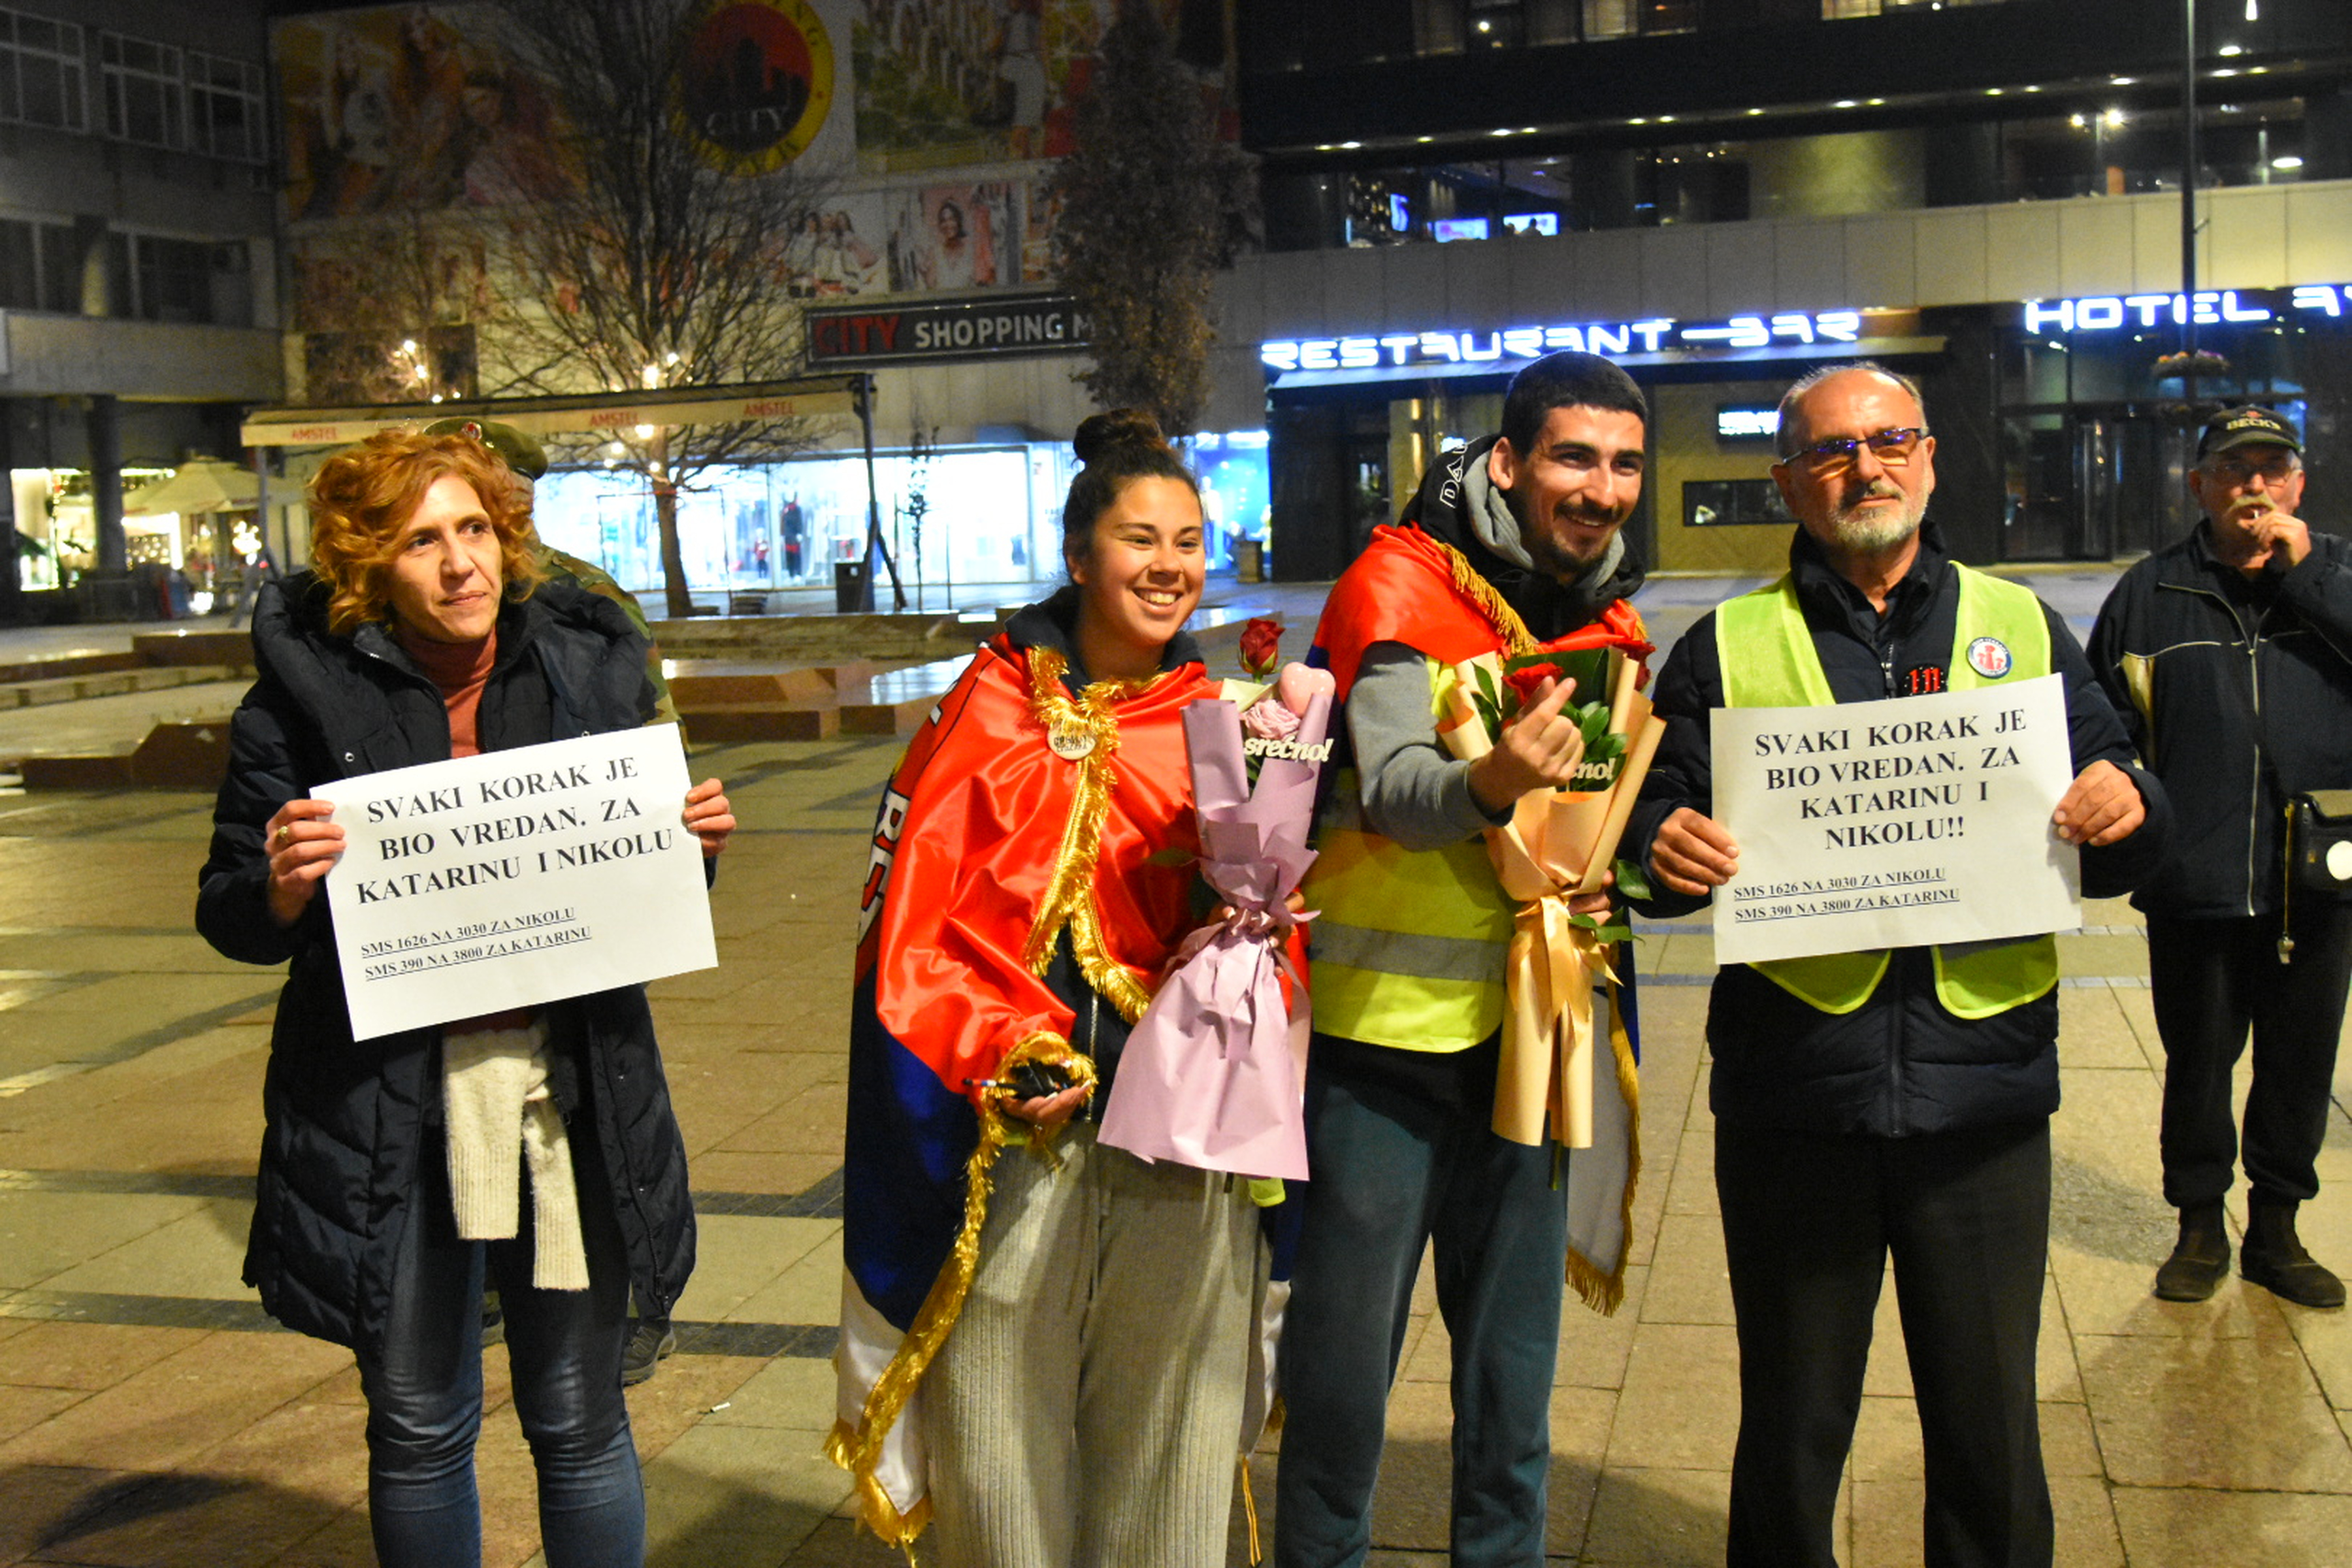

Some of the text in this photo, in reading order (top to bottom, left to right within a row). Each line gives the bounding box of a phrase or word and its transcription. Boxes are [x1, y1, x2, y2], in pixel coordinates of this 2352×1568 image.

[2026, 285, 2352, 332] HOTEL A
[816, 314, 900, 353] CITY
[916, 314, 1064, 349] SHOPPING
[1261, 321, 1672, 370] RESTAURANT
[1756, 709, 2027, 757] SVAKI KORAK JE
[367, 757, 638, 823] SVAKI KORAK JE
[1767, 746, 2021, 790] BIO VREDAN. ZA
[1801, 781, 1988, 819] KATARINU I
[379, 798, 642, 860] BIO VREDAN. ZA
[1825, 816, 1964, 849] NIKOLU!!
[356, 829, 672, 904] KATARINU I NIKOLU
[1734, 868, 1946, 898] SMS 1626 NA 3030 ZA NIKOLU
[1735, 889, 1959, 920] SMS 390 NA 3800 ZA KATARINU
[361, 907, 575, 956] SMS 1626 NA 3030 ZA NIKOLU
[365, 926, 591, 978] SMS 390 NA 3800 ZA KATARINU
